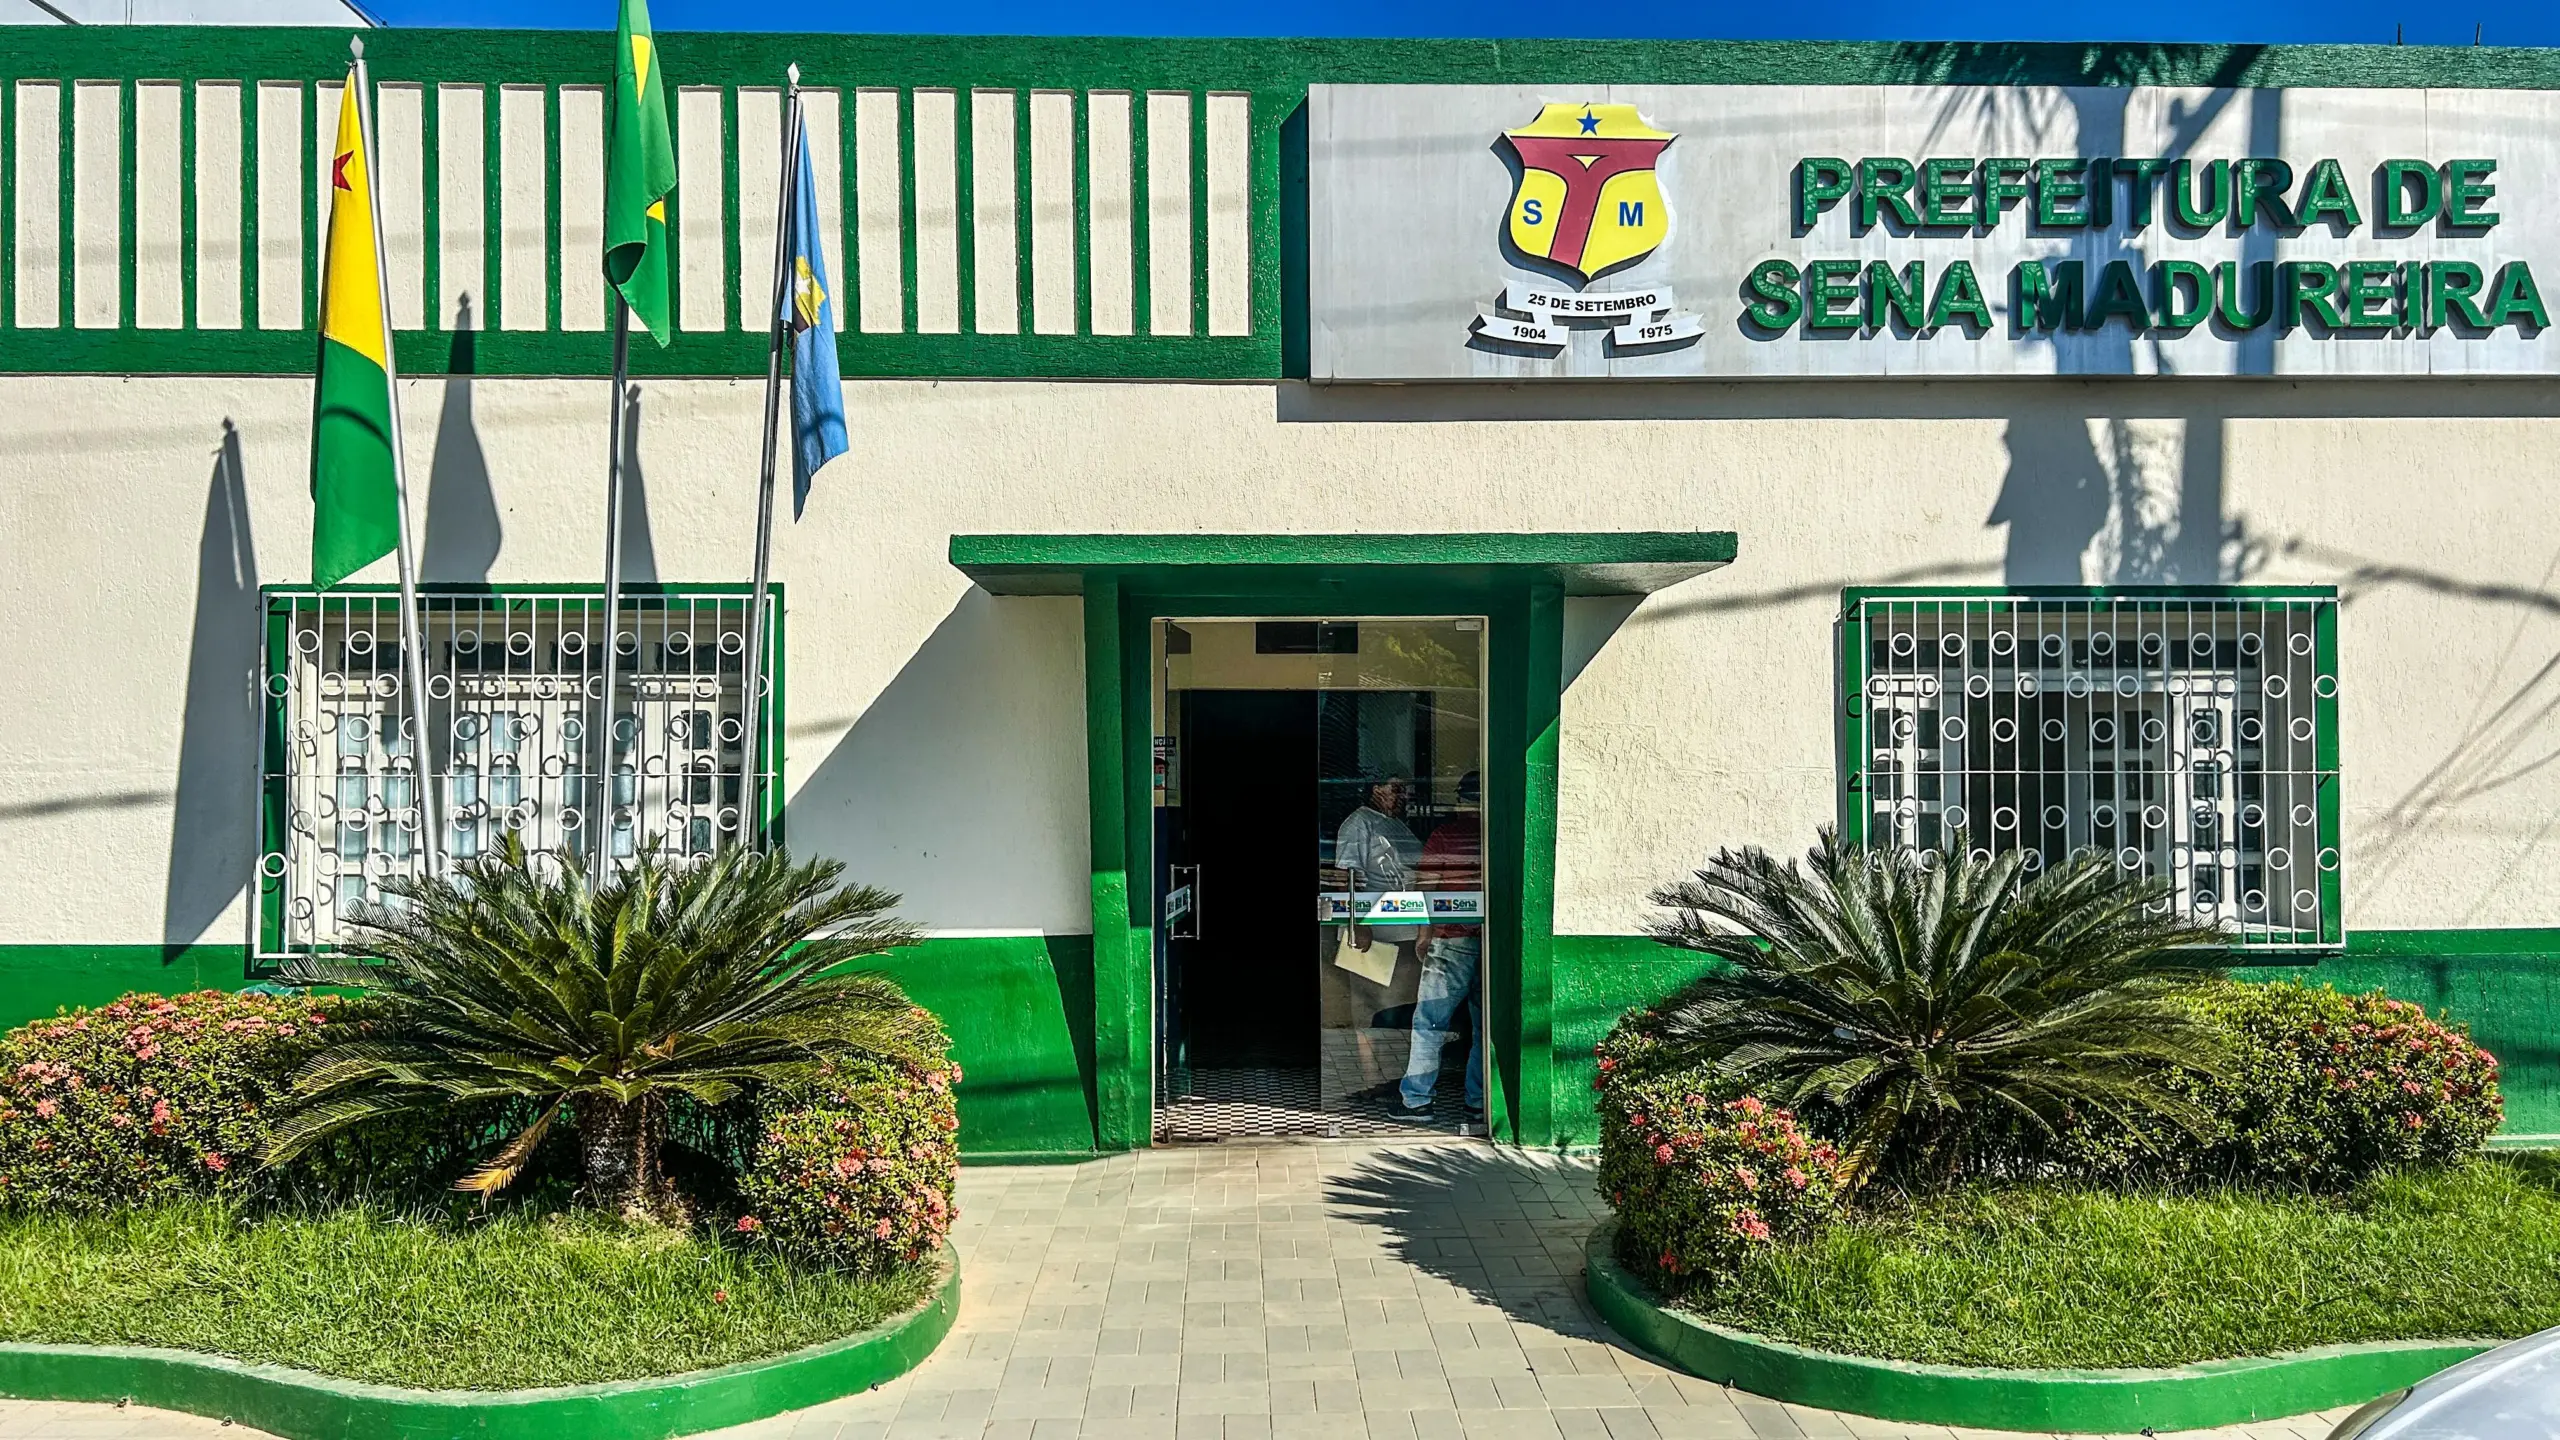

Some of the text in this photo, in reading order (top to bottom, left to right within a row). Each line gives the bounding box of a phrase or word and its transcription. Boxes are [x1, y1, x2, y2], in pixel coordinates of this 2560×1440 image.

[1800, 157, 2501, 227] PREFEITURA DE
[1522, 199, 1643, 227] S M
[1528, 292, 1657, 312] 25 DE SETEMBRO
[1748, 259, 2552, 330] SENA MADUREIRA
[1512, 324, 1547, 340] 1904
[1638, 323, 1673, 339] 1975
[1400, 899, 1424, 910] Sena
[1452, 899, 1477, 910] Sena
